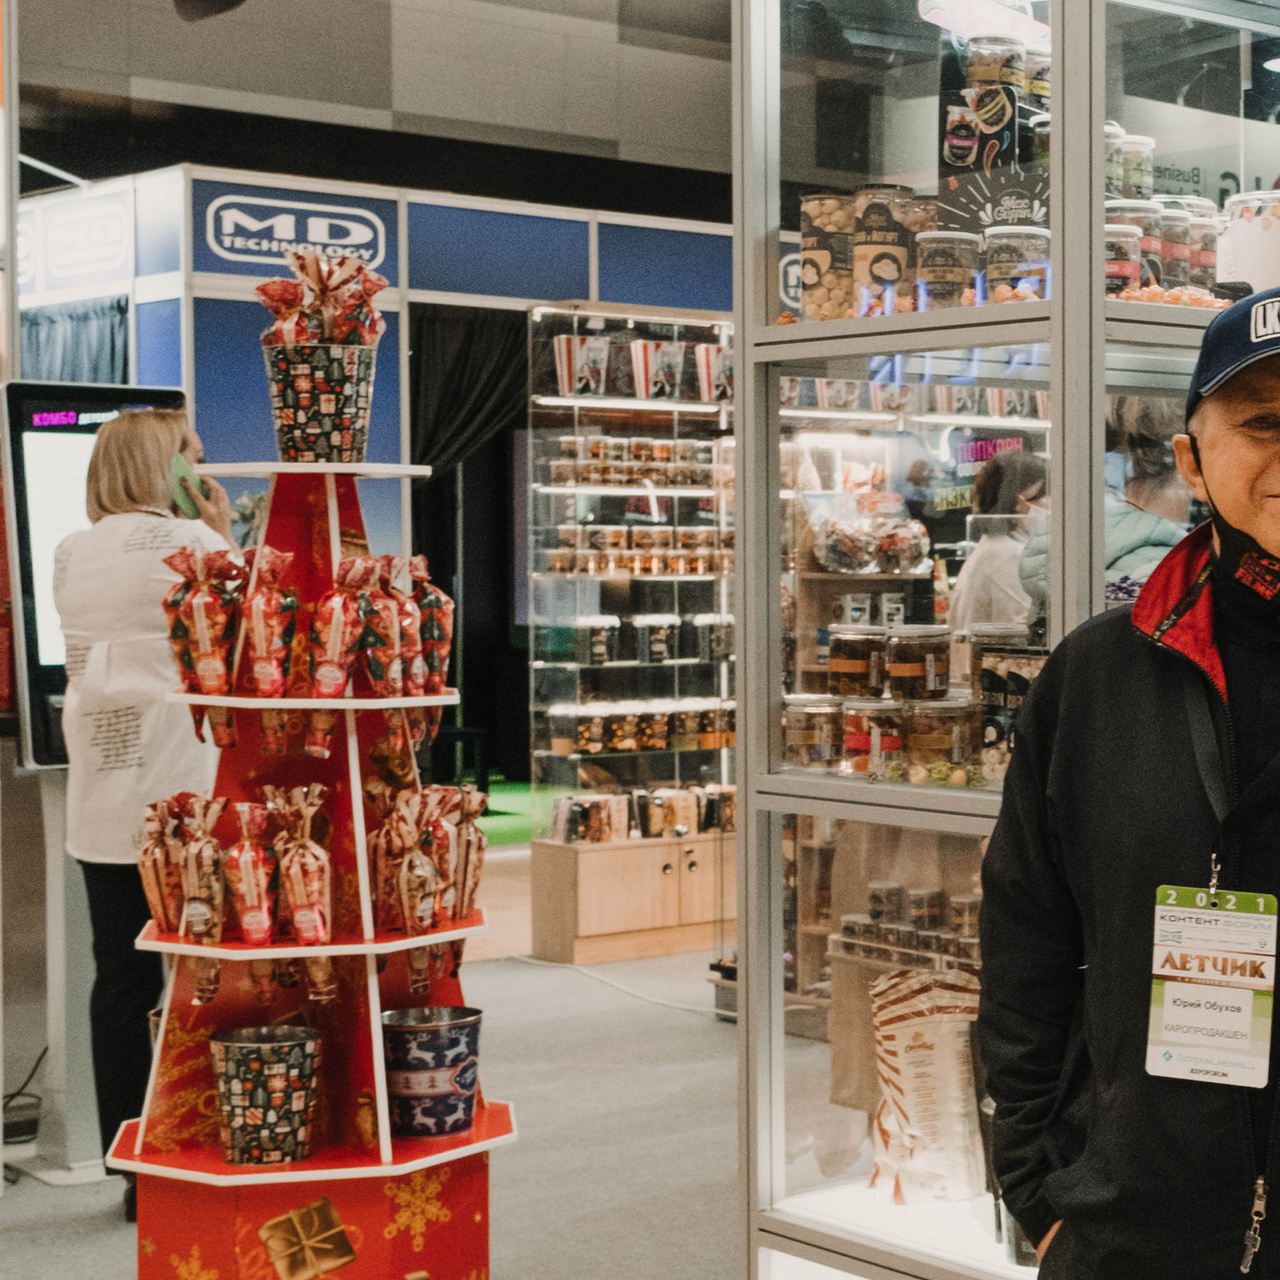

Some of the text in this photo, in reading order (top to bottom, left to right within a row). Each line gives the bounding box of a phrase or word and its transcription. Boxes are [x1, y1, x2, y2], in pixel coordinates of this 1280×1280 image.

[219, 208, 375, 245] MD
[220, 235, 376, 262] TECHNOLOGY
[1160, 914, 1273, 932] КОНТЕНТ ФОРУМ
[1160, 950, 1267, 979] ЛЕТЧИК
[1172, 997, 1243, 1014] Юрий Обухов
